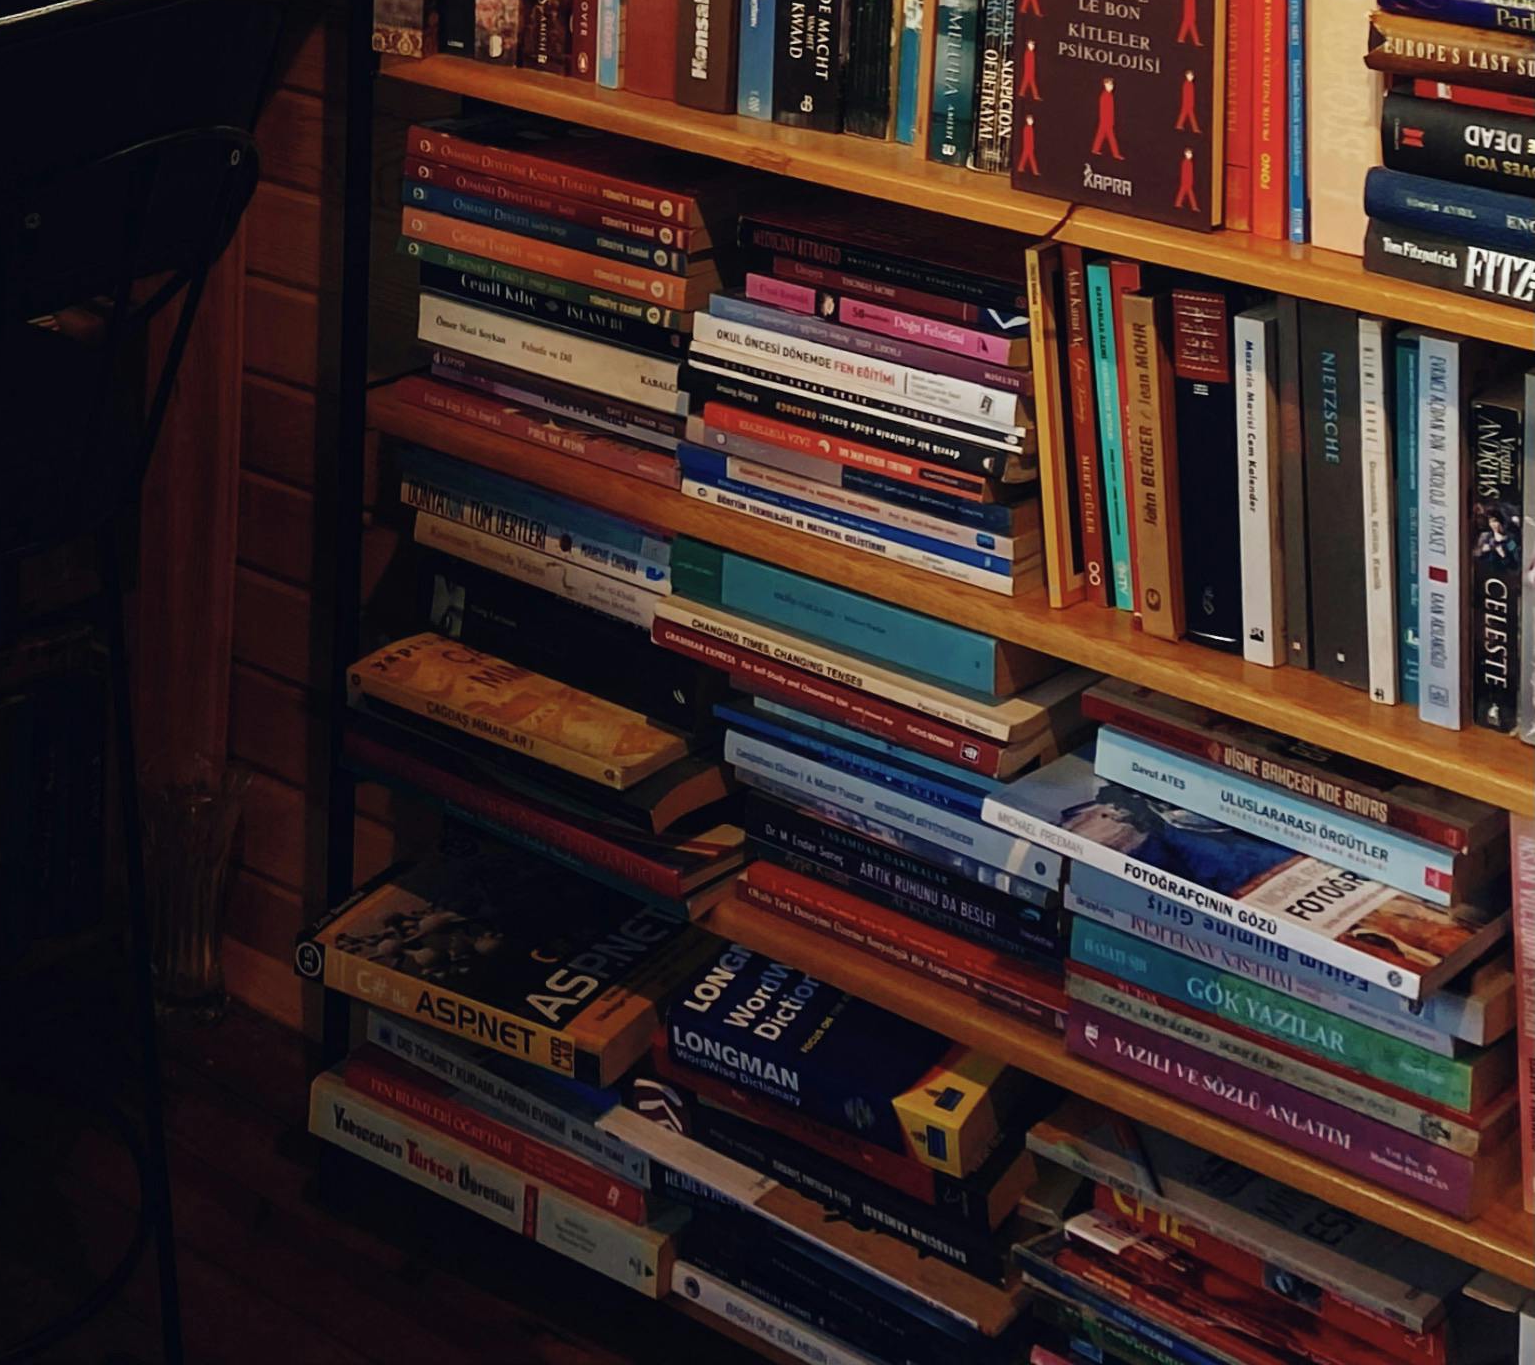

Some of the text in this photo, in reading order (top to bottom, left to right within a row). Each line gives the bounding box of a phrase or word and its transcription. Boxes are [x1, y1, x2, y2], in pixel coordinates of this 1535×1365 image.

[538, 15, 549, 52] AMISH
[787, 1, 807, 59] KWAAD
[1067, 21, 1151, 51] KİTLELER
[1105, 1, 1141, 20] BON
[814, 18, 832, 81] MACHT
[942, 12, 962, 97] MELUHA
[1057, 41, 1161, 75] PSİKOLOJİSİ
[1384, 37, 1509, 73] EUROPE'S LAST
[978, 48, 998, 142] OF BETRAYAL
[997, 59, 1016, 140] SUSPICION
[1259, 152, 1271, 189] FONO
[1382, 238, 1403, 255] Tom
[716, 328, 741, 345] OKUL
[743, 331, 779, 356] ÖNCESİ
[781, 342, 832, 369] DÖNEMDE
[834, 359, 853, 374] FEN
[1320, 350, 1341, 464] NIETZSCHE
[1476, 416, 1503, 500] ANDREWS
[1501, 436, 1516, 485] Virginia
[690, 619, 739, 646] CHANGING
[773, 648, 823, 674] CHANGING
[825, 667, 863, 688] TENSES
[1483, 576, 1509, 688] CELESTE
[1220, 790, 1389, 864] ULUSLARARASI ÖRGÜTLER
[858, 860, 996, 929] ARTIK RUHUNU DA BESLE!
[1123, 861, 1278, 936] FOTOĞRAFÇININ GÖZÜ
[355, 967, 537, 1056] C# ASP.NET
[1185, 976, 1345, 1056] GÖK YAZILAR
[672, 1023, 801, 1093] LONGMAN
[675, 1046, 803, 1107] WordWise Dictionary
[1114, 1034, 1352, 1153] YAZILI VE SÖZLÜ ANLATIM
